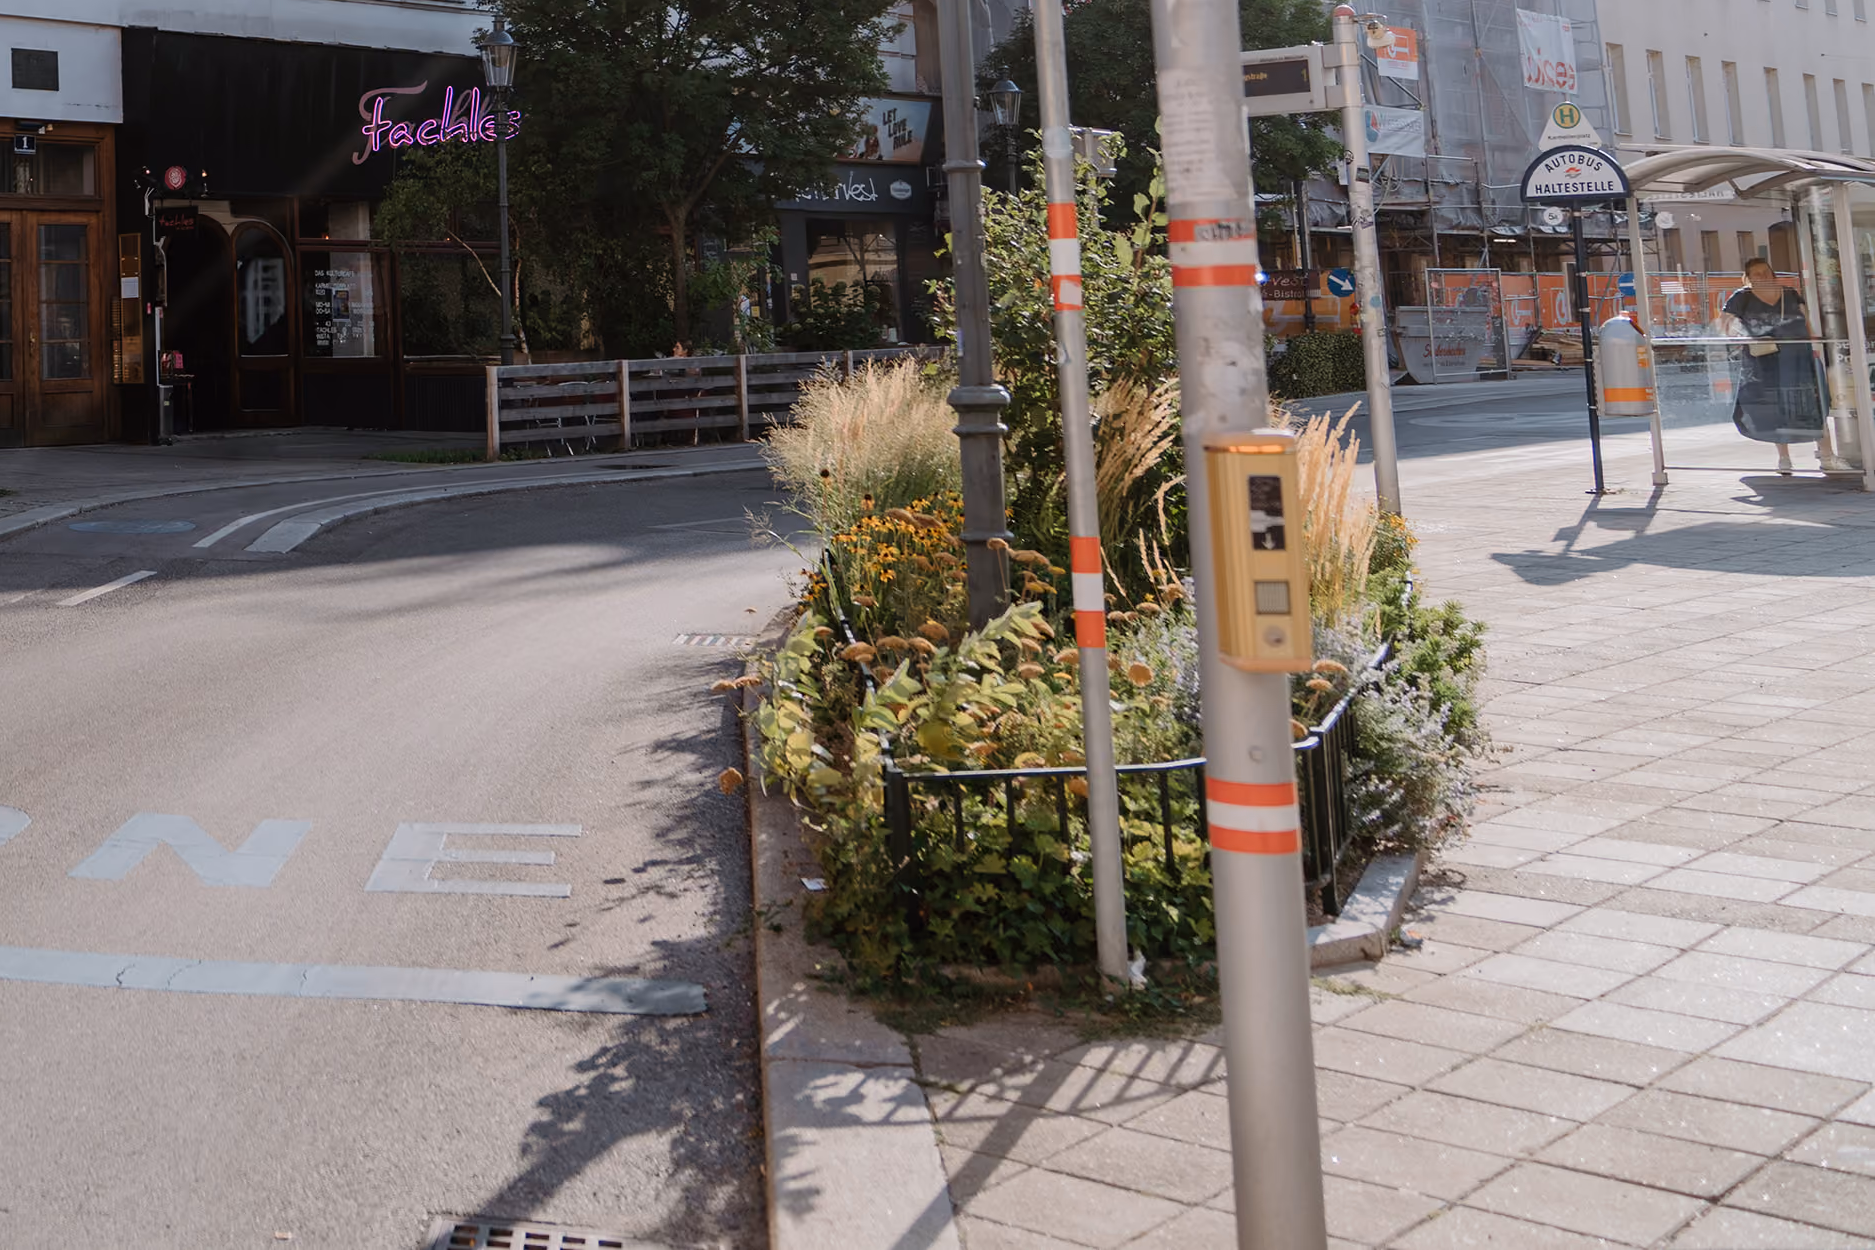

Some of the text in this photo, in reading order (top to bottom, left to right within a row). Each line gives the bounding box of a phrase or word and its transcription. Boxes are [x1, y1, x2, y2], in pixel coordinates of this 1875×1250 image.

[883, 107, 898, 126] LET
[22, 136, 28, 149] 1
[1544, 153, 1603, 173] AUTOBUS
[1535, 180, 1614, 195] HALTESTELLE
